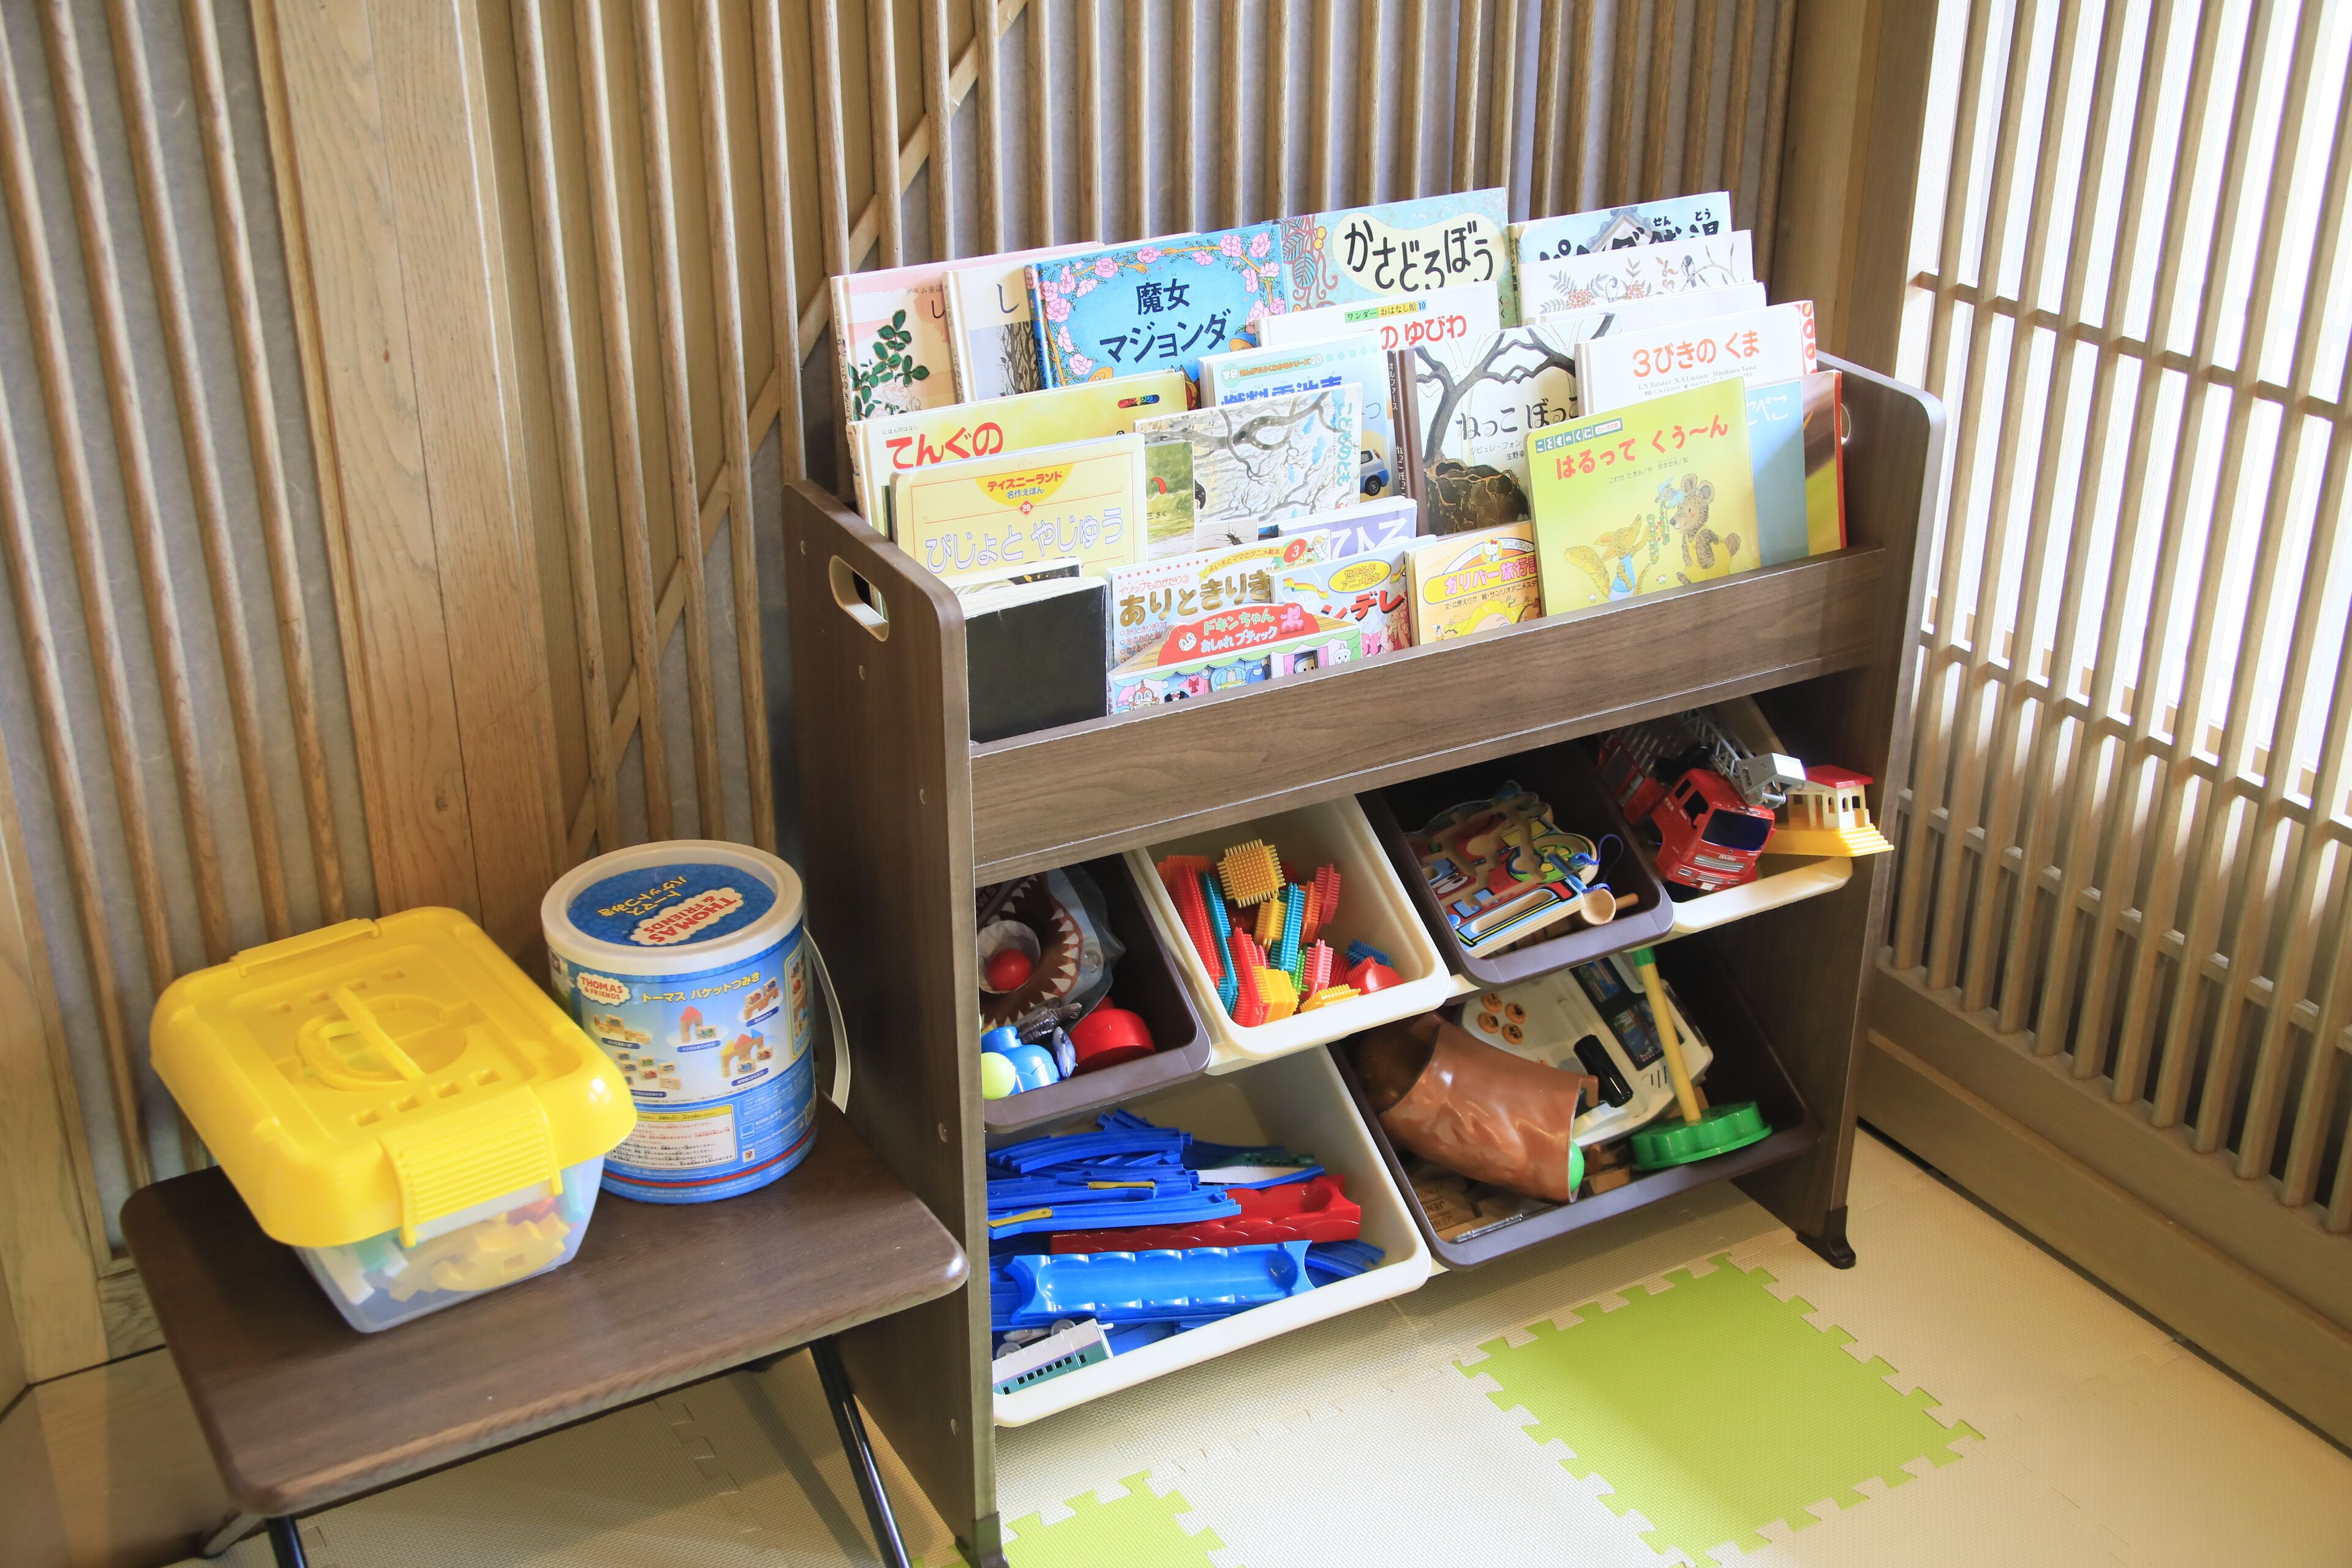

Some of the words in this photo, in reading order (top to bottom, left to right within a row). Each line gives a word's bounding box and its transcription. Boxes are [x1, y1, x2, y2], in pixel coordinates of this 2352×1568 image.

[1653, 216, 1672, 227] せん
[1695, 208, 1711, 222] とう
[1344, 220, 1494, 292] かさどろぼう
[997, 284, 1020, 314] し
[1136, 278, 1190, 315] 魔女
[1347, 311, 1378, 321] ワンダー
[1418, 301, 1427, 311] 10
[1099, 308, 1232, 363] マジョンダ
[1404, 314, 1467, 346] ゆびわ
[1633, 338, 1716, 379] 3びきの
[1725, 329, 1760, 358] くま
[1222, 369, 1239, 381] 学研
[1388, 363, 1398, 411] オルファース
[882, 425, 919, 435] にほんのはなし
[1455, 407, 1518, 440] ねっこ
[886, 422, 1004, 470] てんぐの
[1336, 402, 1353, 487] こどものとも
[1536, 426, 1593, 453] こどものくに
[1556, 437, 1636, 481] はるって
[1006, 486, 1044, 499] 名作えほん
[925, 532, 1024, 574] びじょと
[1030, 507, 1124, 557] やじゅう
[1292, 545, 1300, 558] 3
[1502, 539, 1532, 552] アニメランド
[1340, 572, 1381, 590] アニメ絵本
[1344, 564, 1377, 579] 世界名作
[1204, 608, 1275, 636] ドキンちゃん
[1200, 635, 1235, 653] おしゃれ
[1235, 625, 1278, 646] ブティック
[597, 875, 687, 917] バケットつみき
[626, 890, 682, 916] トーマス
[643, 903, 706, 933] FRIENDS
[648, 897, 738, 943] THOMAS
[581, 976, 624, 994] THOMAS
[590, 989, 621, 1000] FRIENDS
[643, 992, 687, 1003] トーマス
[691, 971, 761, 1000] バケットつみき
